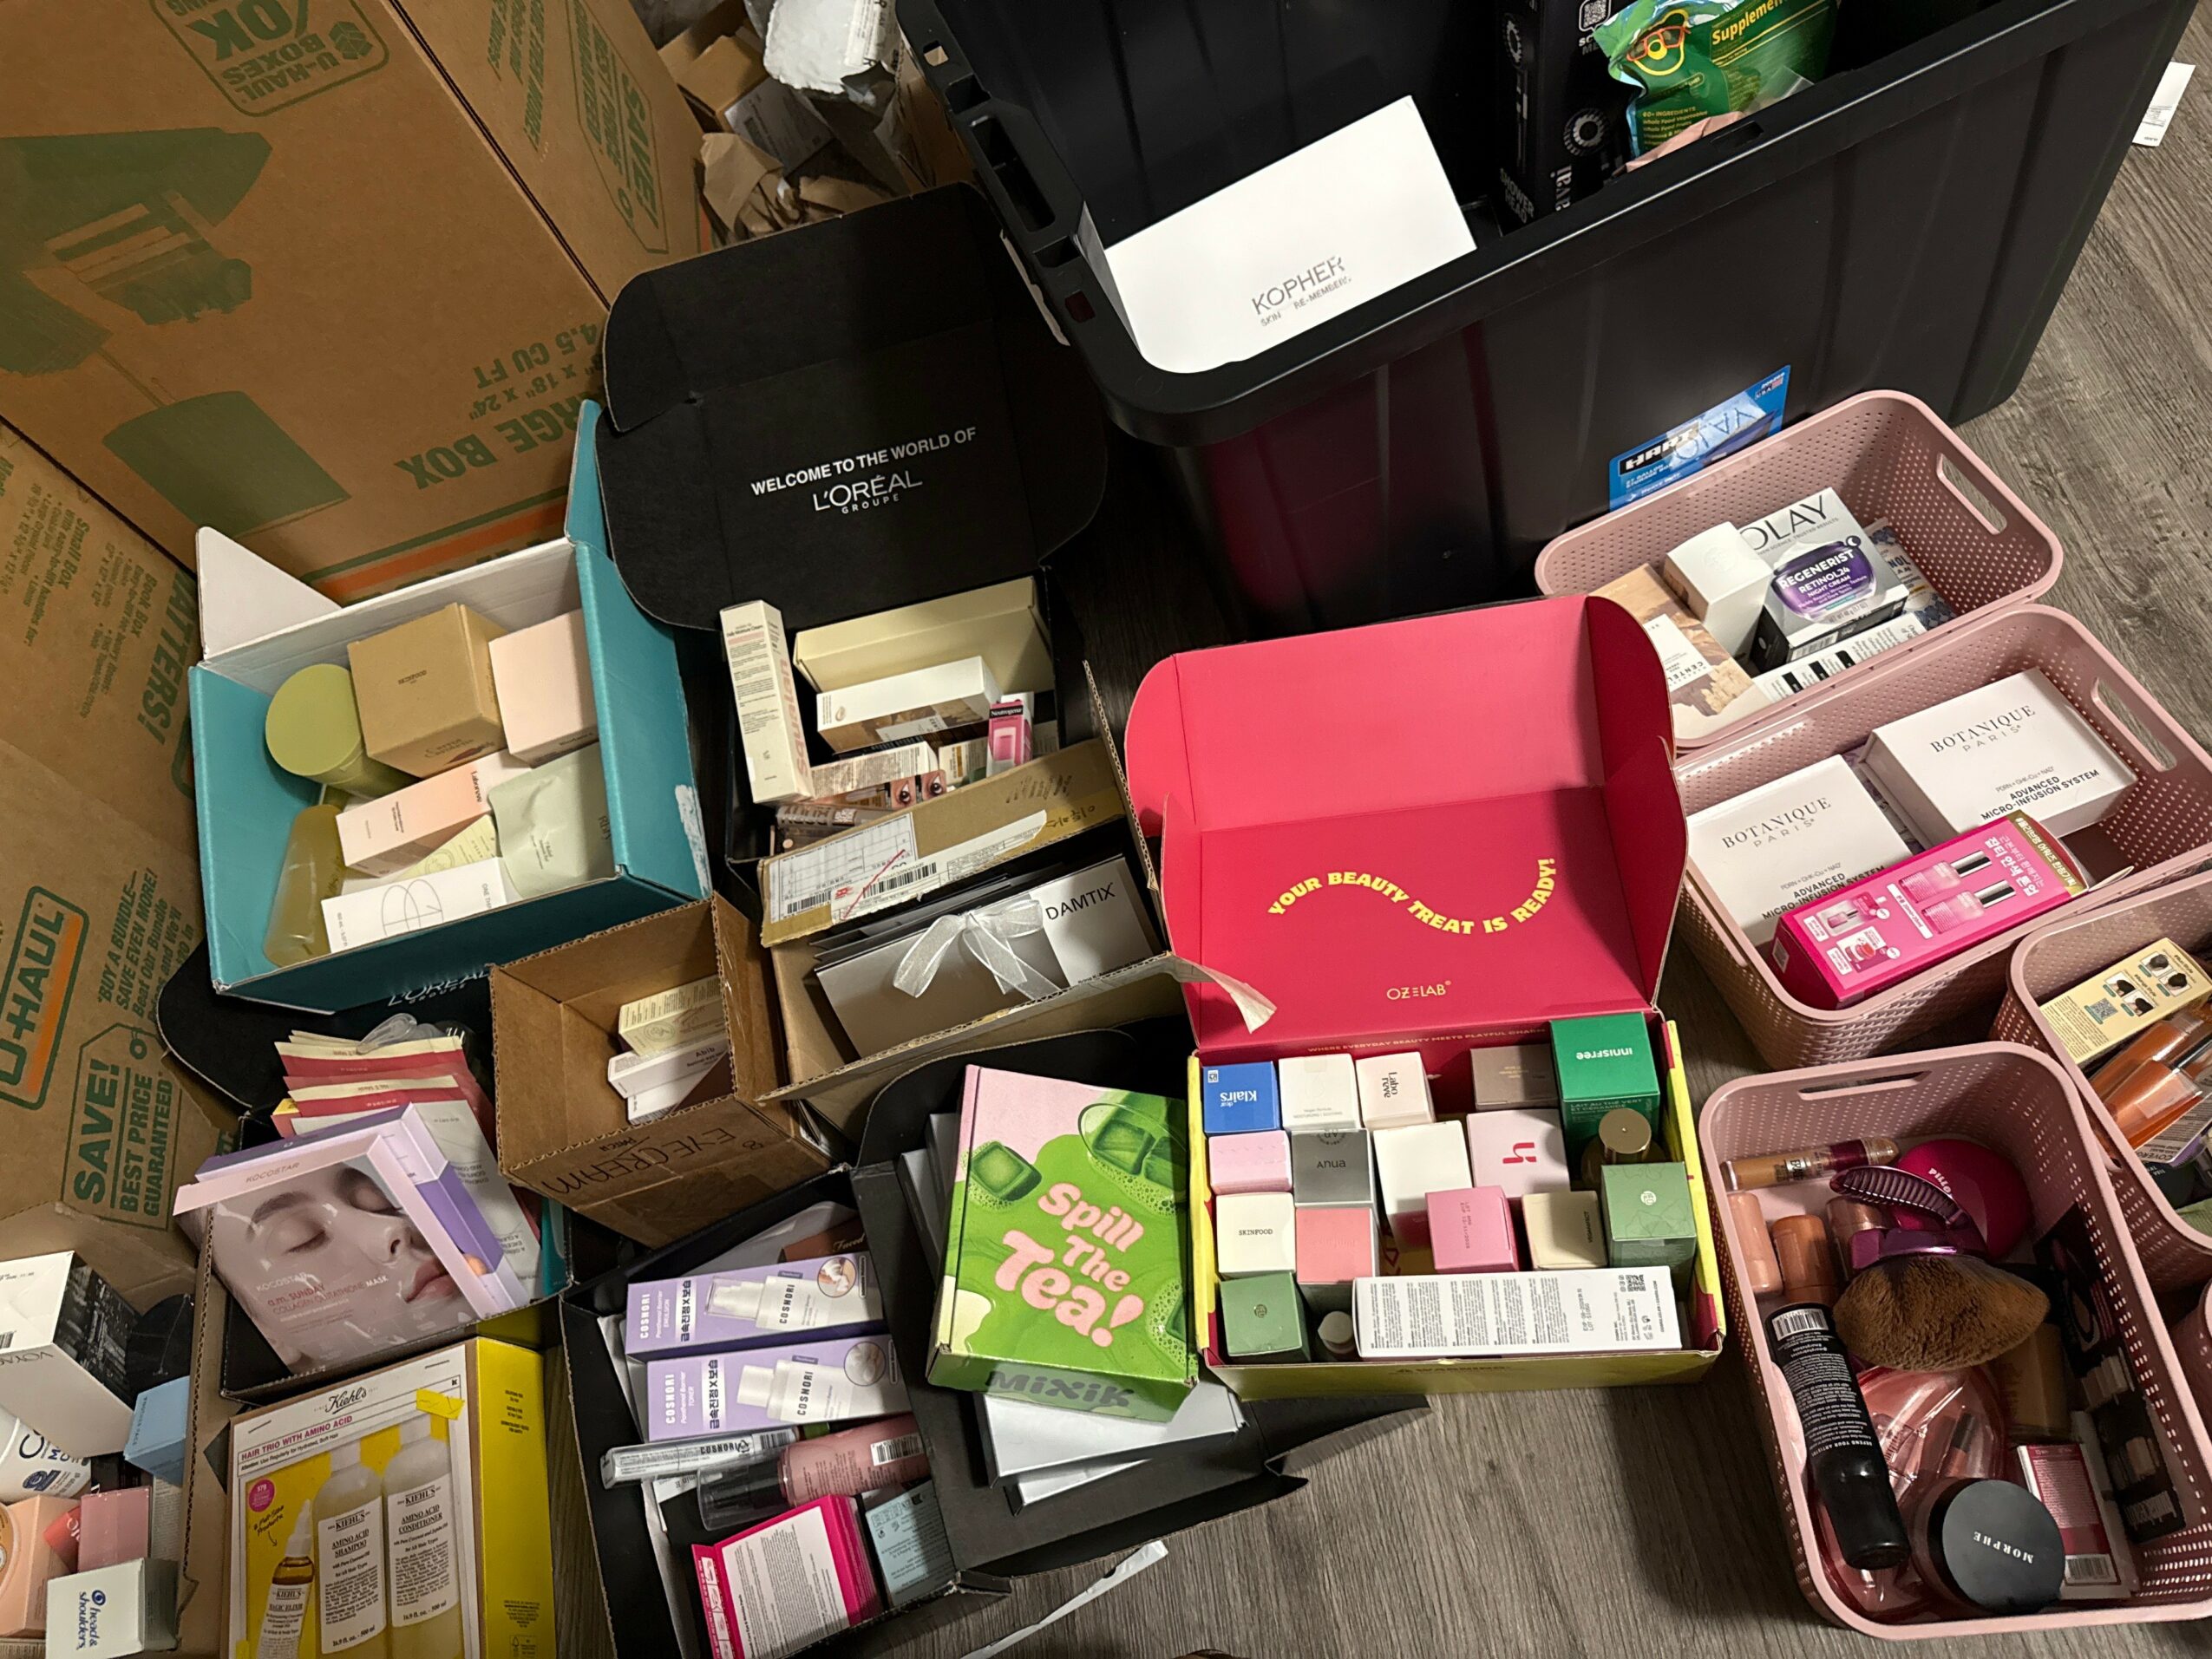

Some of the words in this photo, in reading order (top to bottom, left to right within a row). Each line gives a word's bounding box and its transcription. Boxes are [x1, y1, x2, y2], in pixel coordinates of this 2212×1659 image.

[221, 33, 326, 86] BOXES
[234, 51, 340, 101] U-HAUL
[622, 73, 659, 229] SAVE!
[1251, 256, 1346, 316] KOPHER
[1260, 311, 1282, 328] SKIN
[511, 335, 551, 372] CU
[553, 322, 599, 355] 4.5
[473, 355, 508, 391] FT
[395, 435, 498, 490] BOX
[750, 463, 833, 496] WELCOME
[833, 458, 855, 476] TO
[855, 449, 889, 469] THE
[890, 434, 951, 460] WORLD
[953, 427, 977, 444] OF
[1626, 427, 1698, 471] HART
[812, 470, 923, 512] L'ORÉAL
[841, 493, 900, 514] GROUPE
[69, 517, 90, 562] Small
[1740, 495, 1828, 551] OLAY
[58, 559, 78, 590] Box
[1778, 549, 1855, 591] REGENERIST
[1798, 566, 1851, 594] RETINOL24
[1807, 584, 1828, 598] NIGHT
[1828, 574, 1852, 591] CREAM
[138, 573, 158, 608] Book
[131, 611, 149, 638] Box
[990, 708, 1024, 716] Neutrogena
[1929, 704, 2037, 754] BOTANIQUE
[1962, 723, 2023, 754] PARIS
[1980, 782, 2061, 820] MICRO-INFUSION
[2058, 769, 2100, 793] SYSTEM
[2009, 775, 2060, 801] ADVANCED
[1722, 796, 1831, 849] BOTANIQUE
[1752, 819, 1812, 848] PARIS
[1983, 835, 2006, 858] 잡티
[1999, 854, 2021, 877] 안색
[2015, 873, 2039, 897] 톤업
[1044, 884, 1116, 921] DAMTIX
[1267, 876, 1323, 916] YOUR
[1327, 871, 1410, 904] BEAUTY
[1407, 900, 1475, 935] TREAT
[1482, 916, 1508, 934] IS
[1509, 858, 1558, 924] READY!
[1762, 877, 1846, 921] MICRO-INFUSION
[1846, 865, 1885, 886] SYSTEM
[1792, 872, 1846, 898] ADVANCED
[116, 964, 136, 1010] SAVE
[126, 921, 146, 967] EVEN
[136, 867, 159, 924] MORE!
[147, 898, 168, 951] Bundle
[108, 950, 121, 967] A
[141, 954, 158, 981] Our
[160, 944, 173, 976] and
[0, 909, 65, 1087] U-HAUL
[133, 980, 151, 1019] Beat
[696, 1046, 716, 1059] Abib
[1343, 1042, 1391, 1051] EVERYDAY
[1392, 1038, 1430, 1048] BEAUTY
[1432, 1035, 1463, 1043] MEETS
[1464, 1031, 1507, 1040] PLAYFUL
[1220, 1089, 1257, 1102] Klairs
[1388, 1071, 1398, 1095] Labo
[128, 1072, 154, 1139] PRICE
[74, 1058, 121, 1205] SAVE!
[143, 1080, 173, 1218] GUARANTEED
[662, 1127, 736, 1158] EYE
[120, 1140, 147, 1214] BEST
[245, 1161, 300, 1184] KOCOSTAR
[541, 1145, 671, 1195] CREAM
[1037, 1182, 1144, 1253] Spill
[1239, 1228, 1273, 1237] SKINFOOD
[833, 1236, 864, 1251] Faced
[1062, 1234, 1131, 1292] The
[289, 1283, 326, 1302] SUNDAY
[365, 1274, 389, 1288] MASK
[994, 1229, 1144, 1348] Tea!
[639, 1293, 651, 1339] COSNORI
[779, 1283, 795, 1325] COSNORI
[325, 1387, 369, 1414] Kiehl's
[666, 1373, 677, 1425] COSNORI
[796, 1369, 814, 1416] COSNORI
[241, 1447, 260, 1461] HAIR
[261, 1440, 281, 1454] TRIO
[282, 1433, 303, 1447] WITH
[304, 1422, 331, 1440] AMINO
[332, 1414, 354, 1430] ACID
[700, 1441, 740, 1456] COSNORI
[405, 1487, 435, 1505] KIEHL'S
[336, 1512, 365, 1531] KIEHL'S
[398, 1512, 443, 1535] CONDITIONER
[401, 1511, 423, 1525] AMINO
[425, 1504, 440, 1516] ACID
[332, 1534, 354, 1550] AMINO
[354, 1529, 370, 1542] ACID
[335, 1539, 367, 1559] SHAMPOO
[1972, 1530, 2036, 1565] MORPHE
[276, 1588, 302, 1598] KIEHL'S
[88, 1605, 100, 1636] head
[88, 1636, 98, 1648] &
